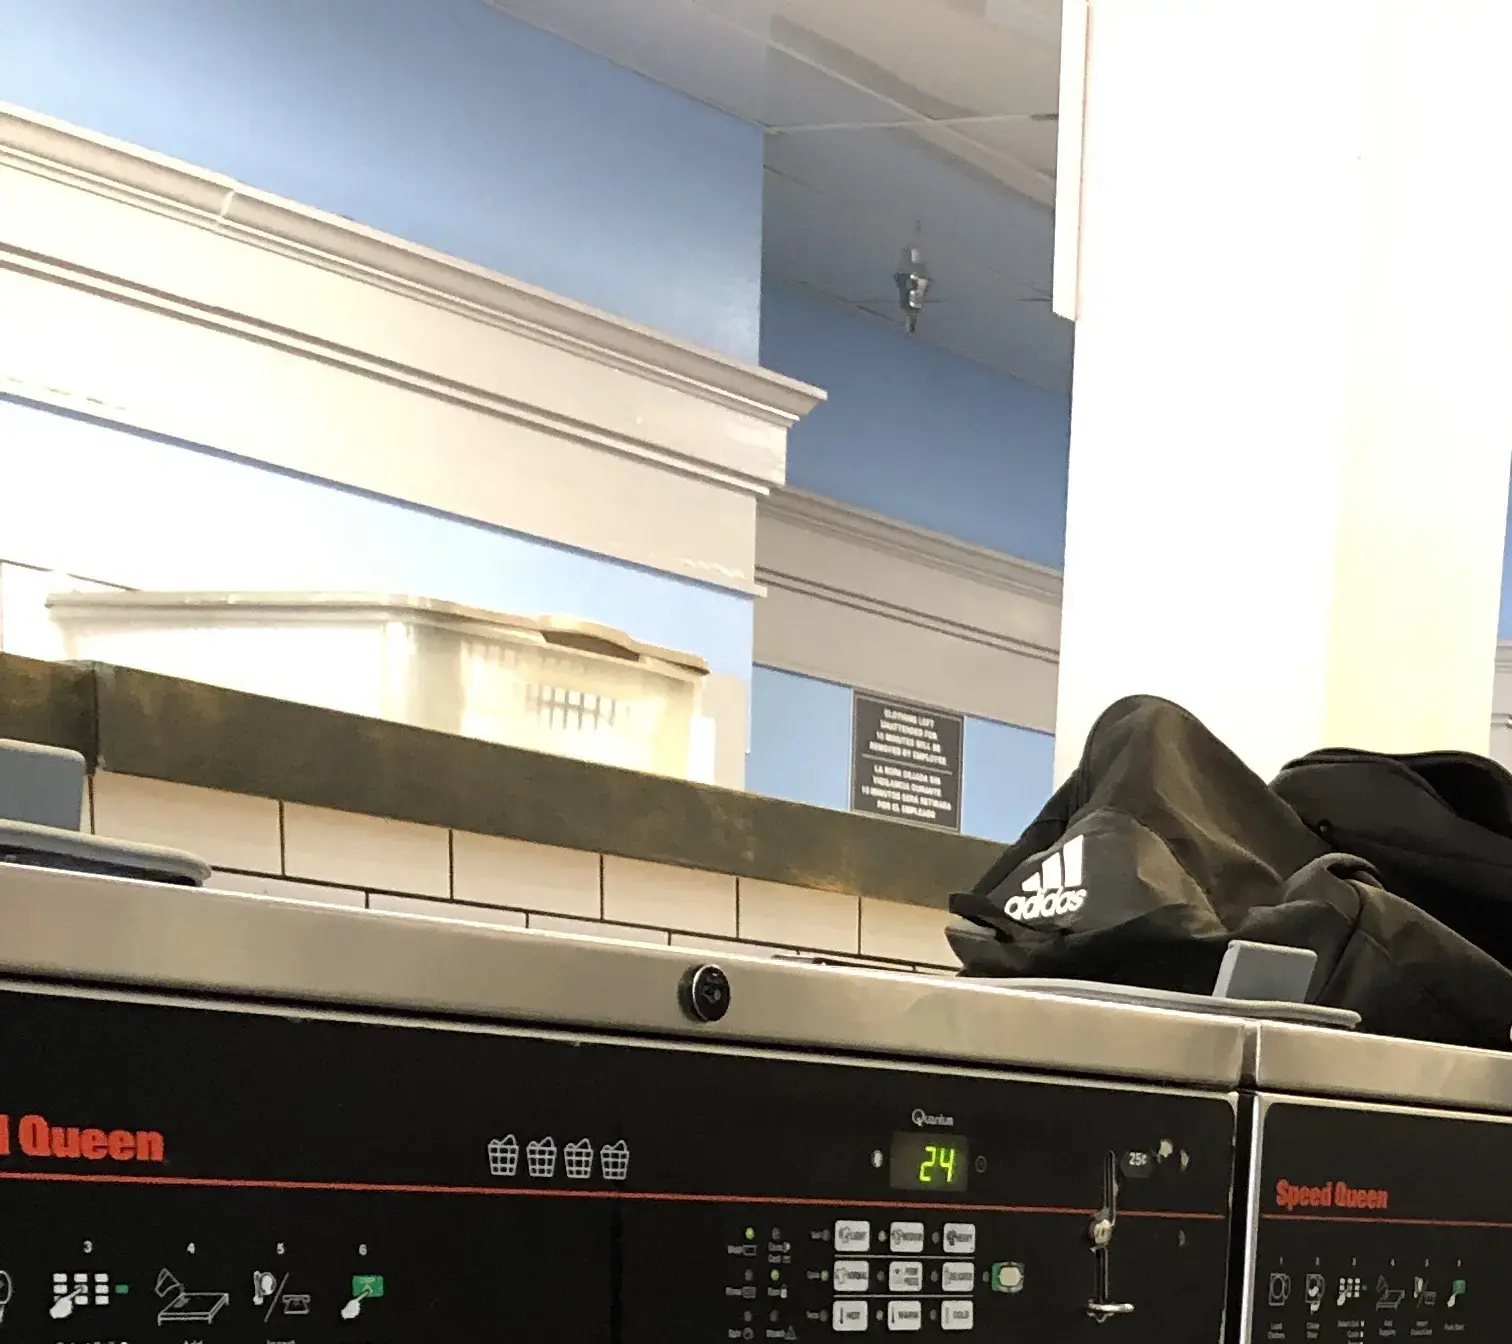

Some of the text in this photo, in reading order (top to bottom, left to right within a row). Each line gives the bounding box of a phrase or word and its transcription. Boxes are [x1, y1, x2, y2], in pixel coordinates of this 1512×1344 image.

[1004, 888, 1087, 920] adidas
[19, 1114, 164, 1160] Queen
[920, 1145, 955, 1182] 24
[1276, 1179, 1388, 1212] Speed Queen
[83, 1240, 93, 1253] 3
[187, 1242, 196, 1254] 4
[276, 1242, 285, 1255] 5
[358, 1243, 368, 1256] 6
